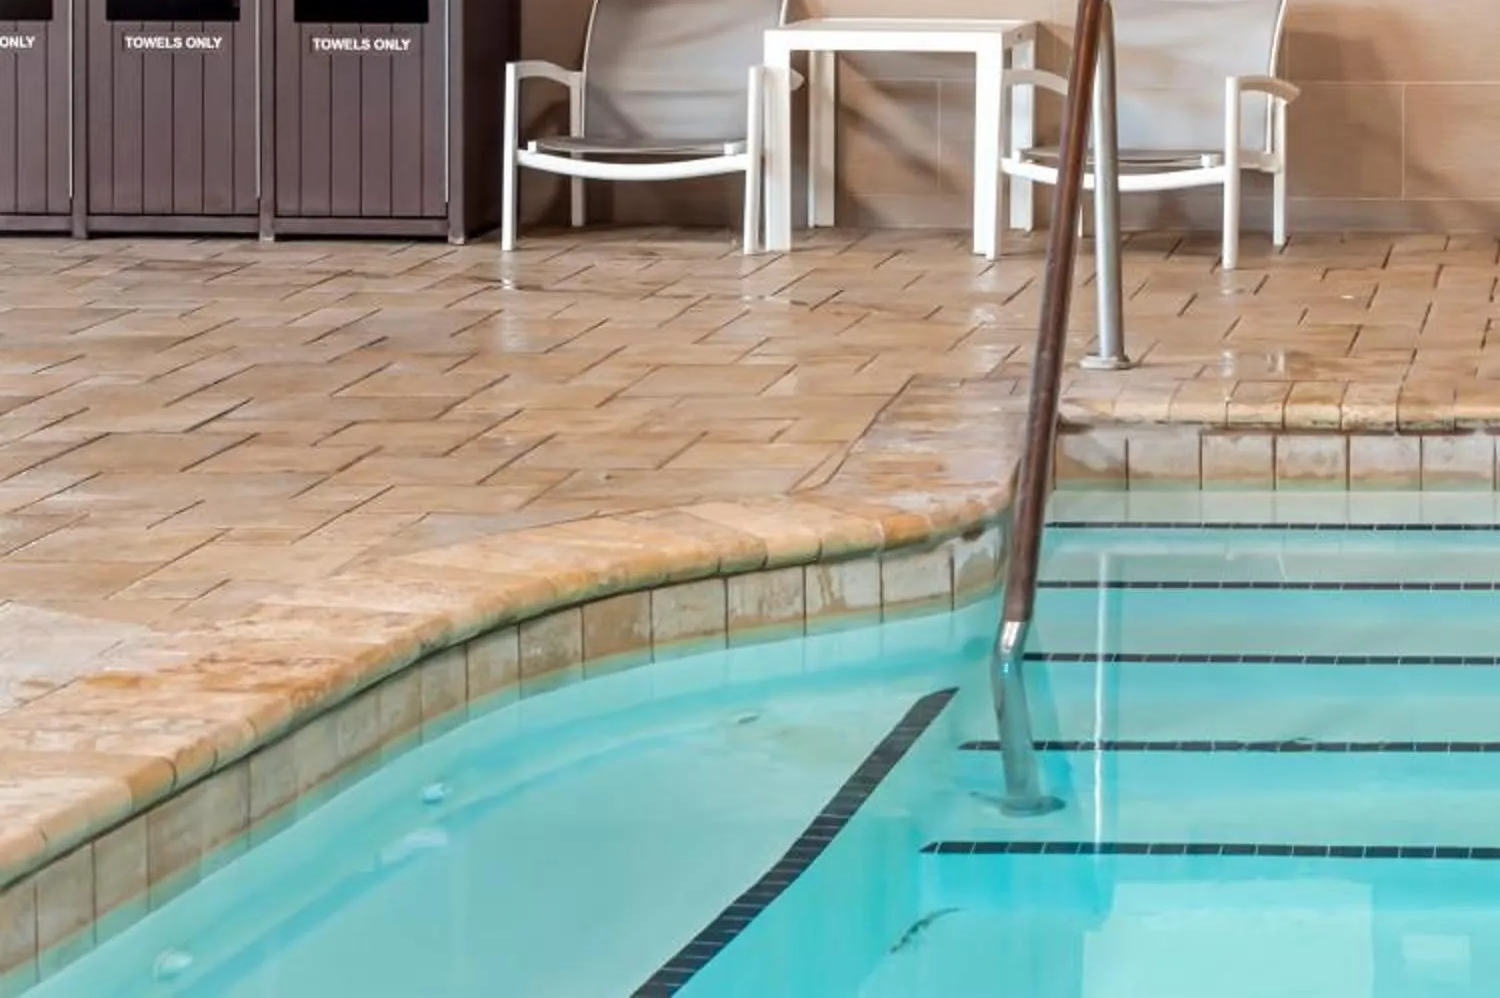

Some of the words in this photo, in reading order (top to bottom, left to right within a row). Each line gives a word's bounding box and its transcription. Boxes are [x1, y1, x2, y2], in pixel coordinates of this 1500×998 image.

[125, 36, 183, 49] TOWELS
[185, 36, 223, 49] ONLY
[313, 38, 371, 51] TOWELS
[374, 38, 411, 51] ONLY
